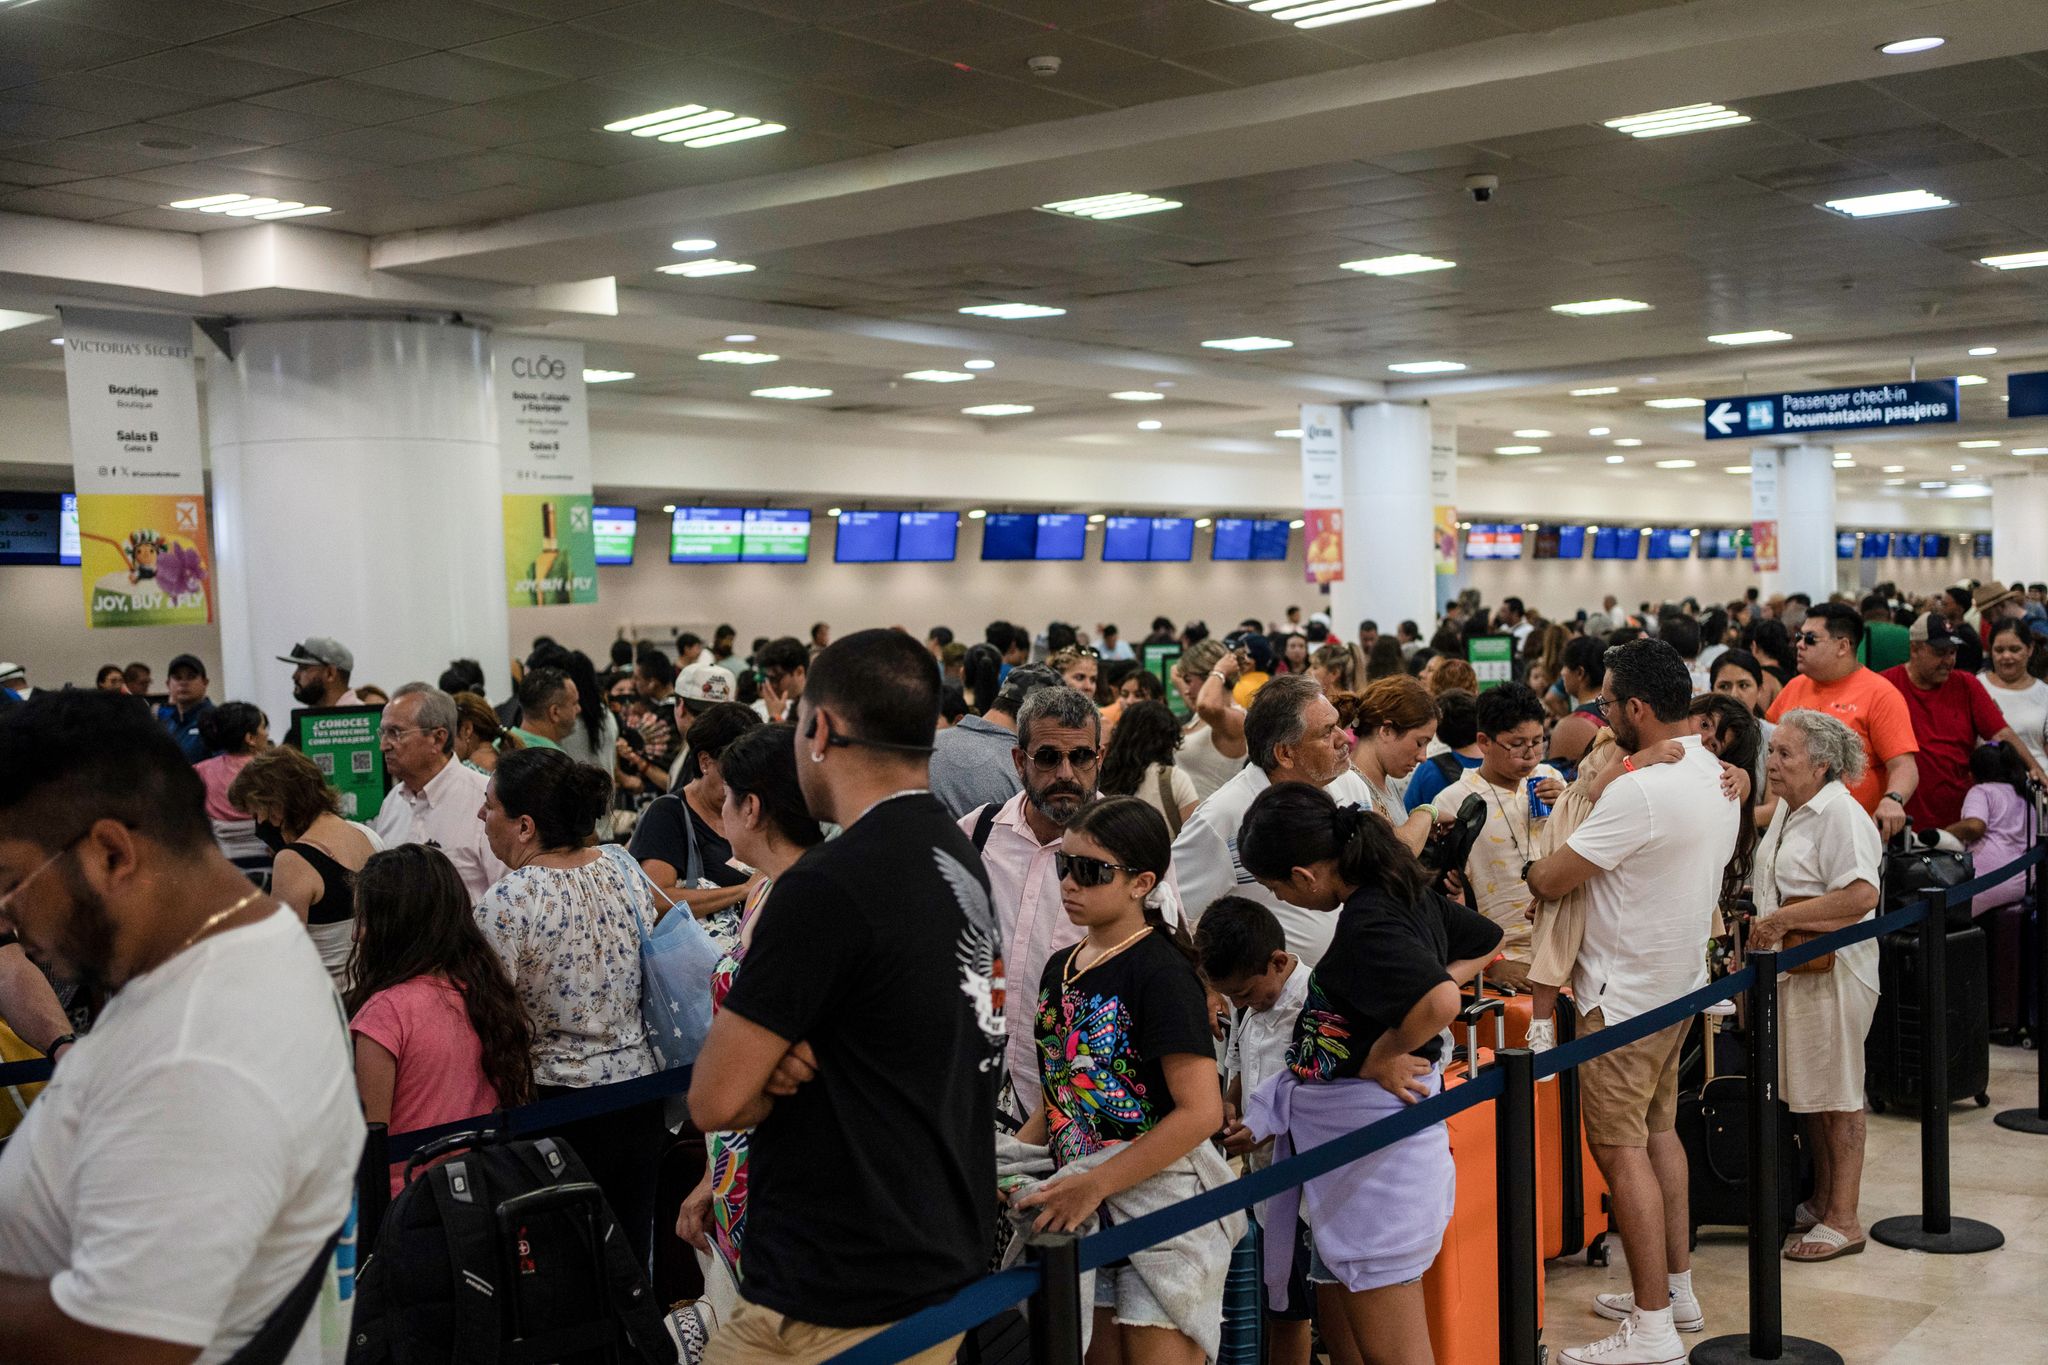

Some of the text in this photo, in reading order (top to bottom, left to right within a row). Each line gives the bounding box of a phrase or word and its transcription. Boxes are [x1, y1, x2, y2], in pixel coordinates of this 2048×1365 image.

[145, 343, 188, 358] SECRET
[108, 384, 159, 397] Boutique
[117, 400, 153, 410] Boutique
[1783, 386, 1907, 411] Passenger check-in
[1783, 401, 1948, 428] Documentación pasajeros
[116, 430, 159, 443] Salas B
[94, 594, 128, 612] JOY,
[132, 592, 162, 609] BUY
[313, 718, 370, 730] ¿CONOCES
